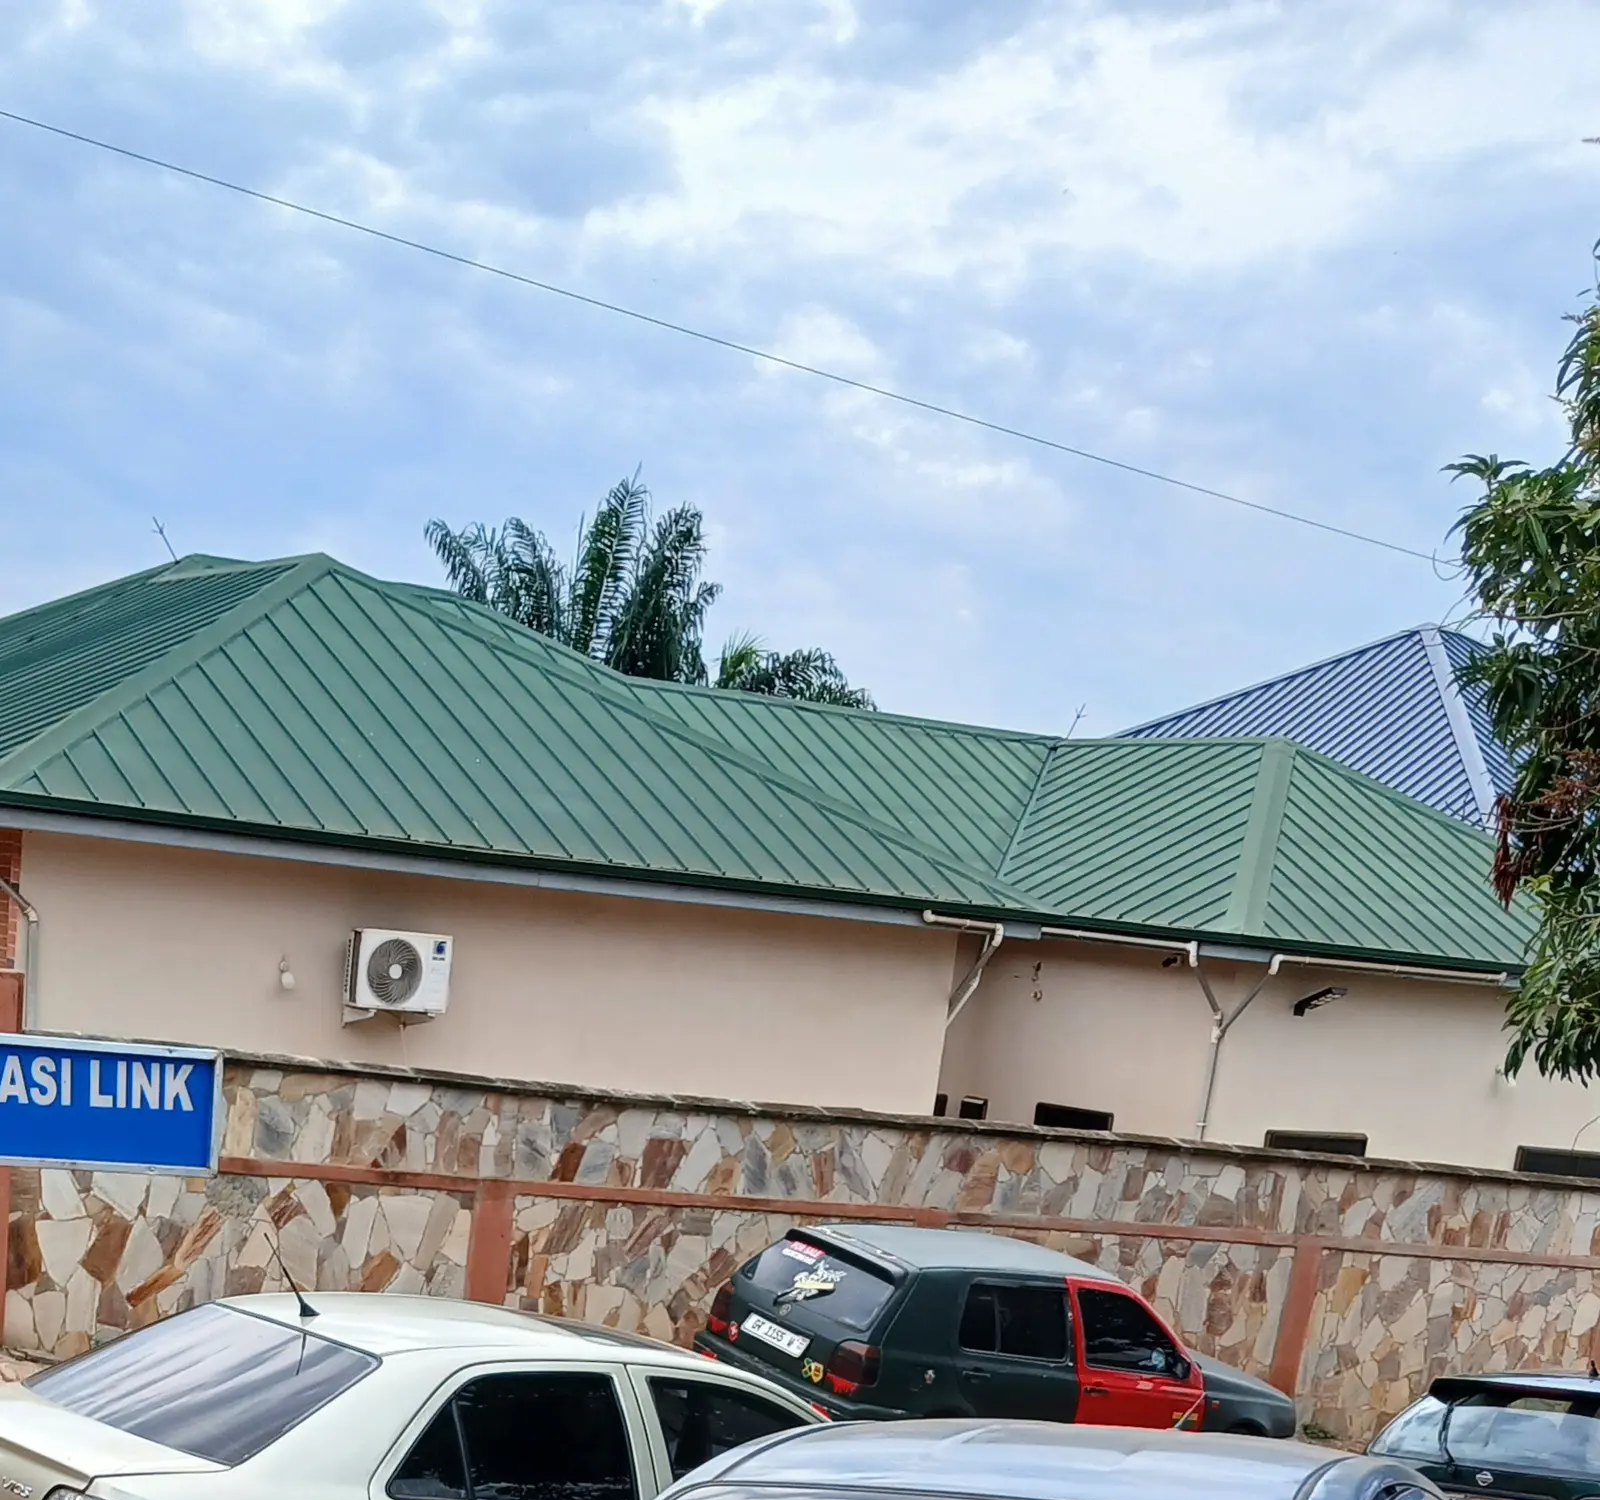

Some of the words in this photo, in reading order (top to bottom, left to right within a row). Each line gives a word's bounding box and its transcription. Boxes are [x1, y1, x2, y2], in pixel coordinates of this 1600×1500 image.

[0, 1055, 72, 1106] ASI
[89, 1059, 194, 1111] LINK
[764, 1326, 786, 1342] 1155
[2, 1476, 33, 1498] VIOS
